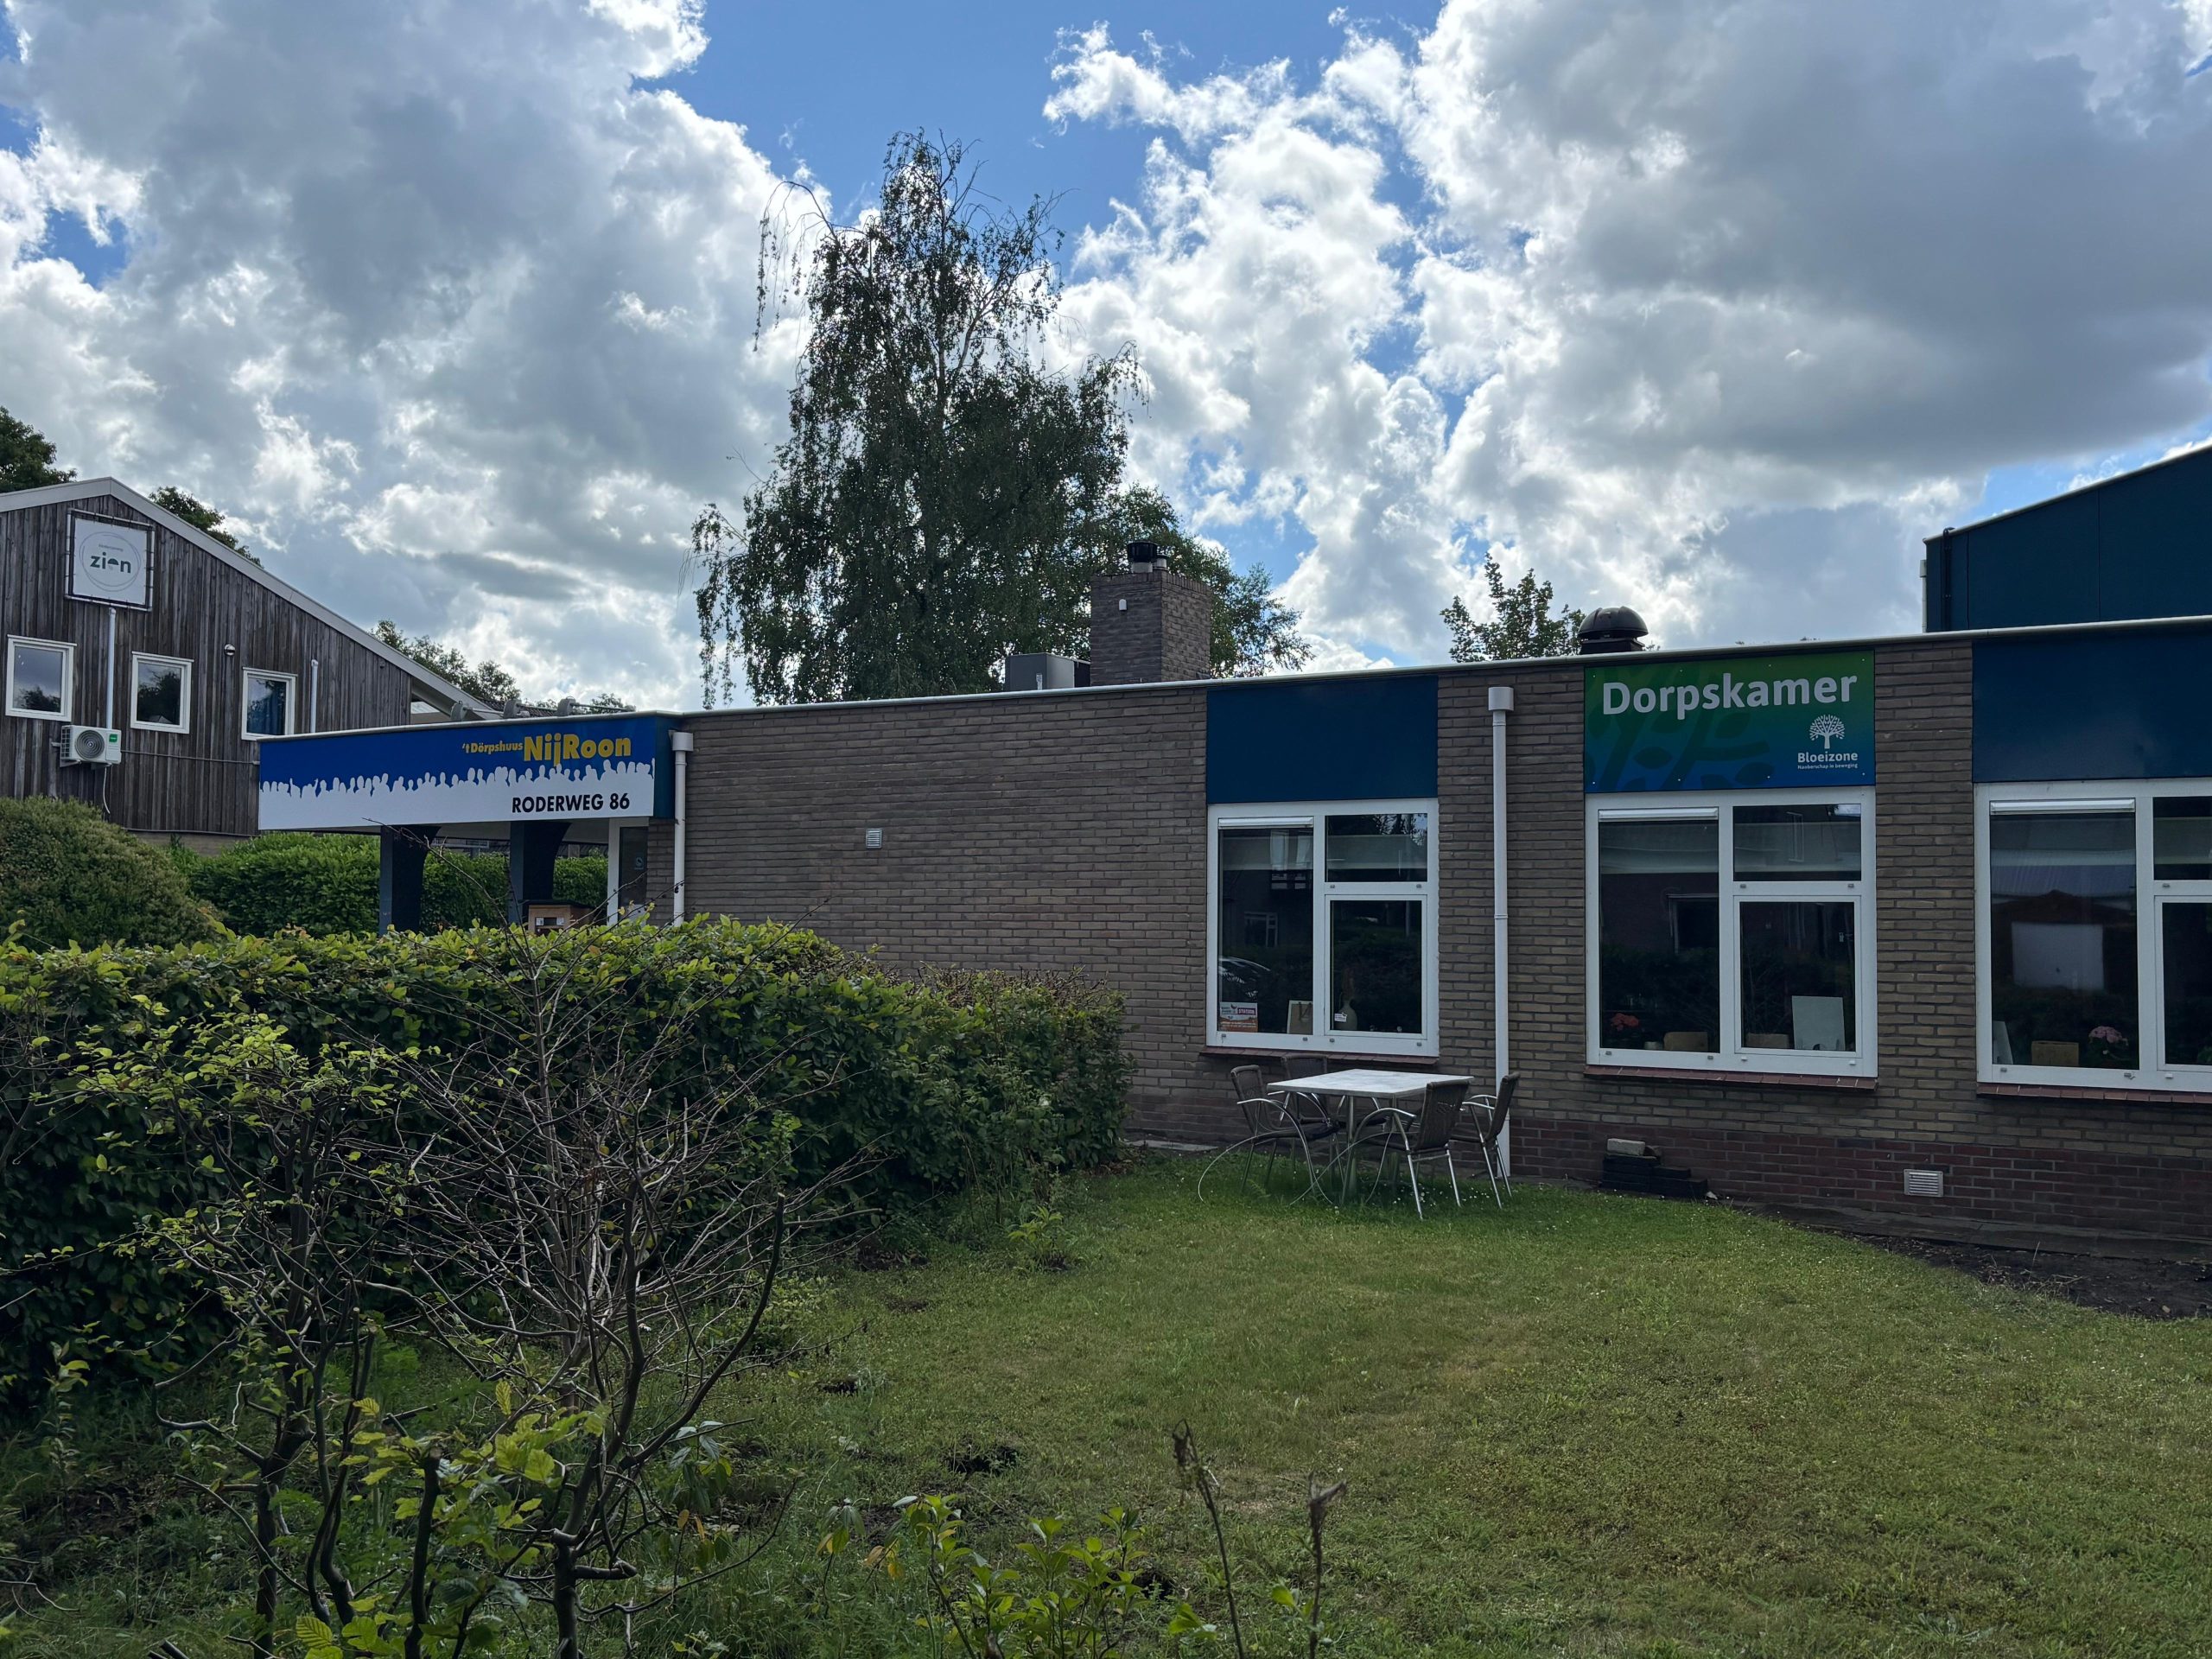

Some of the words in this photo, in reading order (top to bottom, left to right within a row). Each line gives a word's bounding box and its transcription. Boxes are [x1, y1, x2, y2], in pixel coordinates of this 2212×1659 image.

[1603, 672, 1858, 720] Dorpskamer
[470, 741, 524, 754] Dörpshuus
[1797, 751, 1859, 763] Bloeizone
[512, 793, 604, 813] RODERWEG
[609, 792, 630, 810] 86
